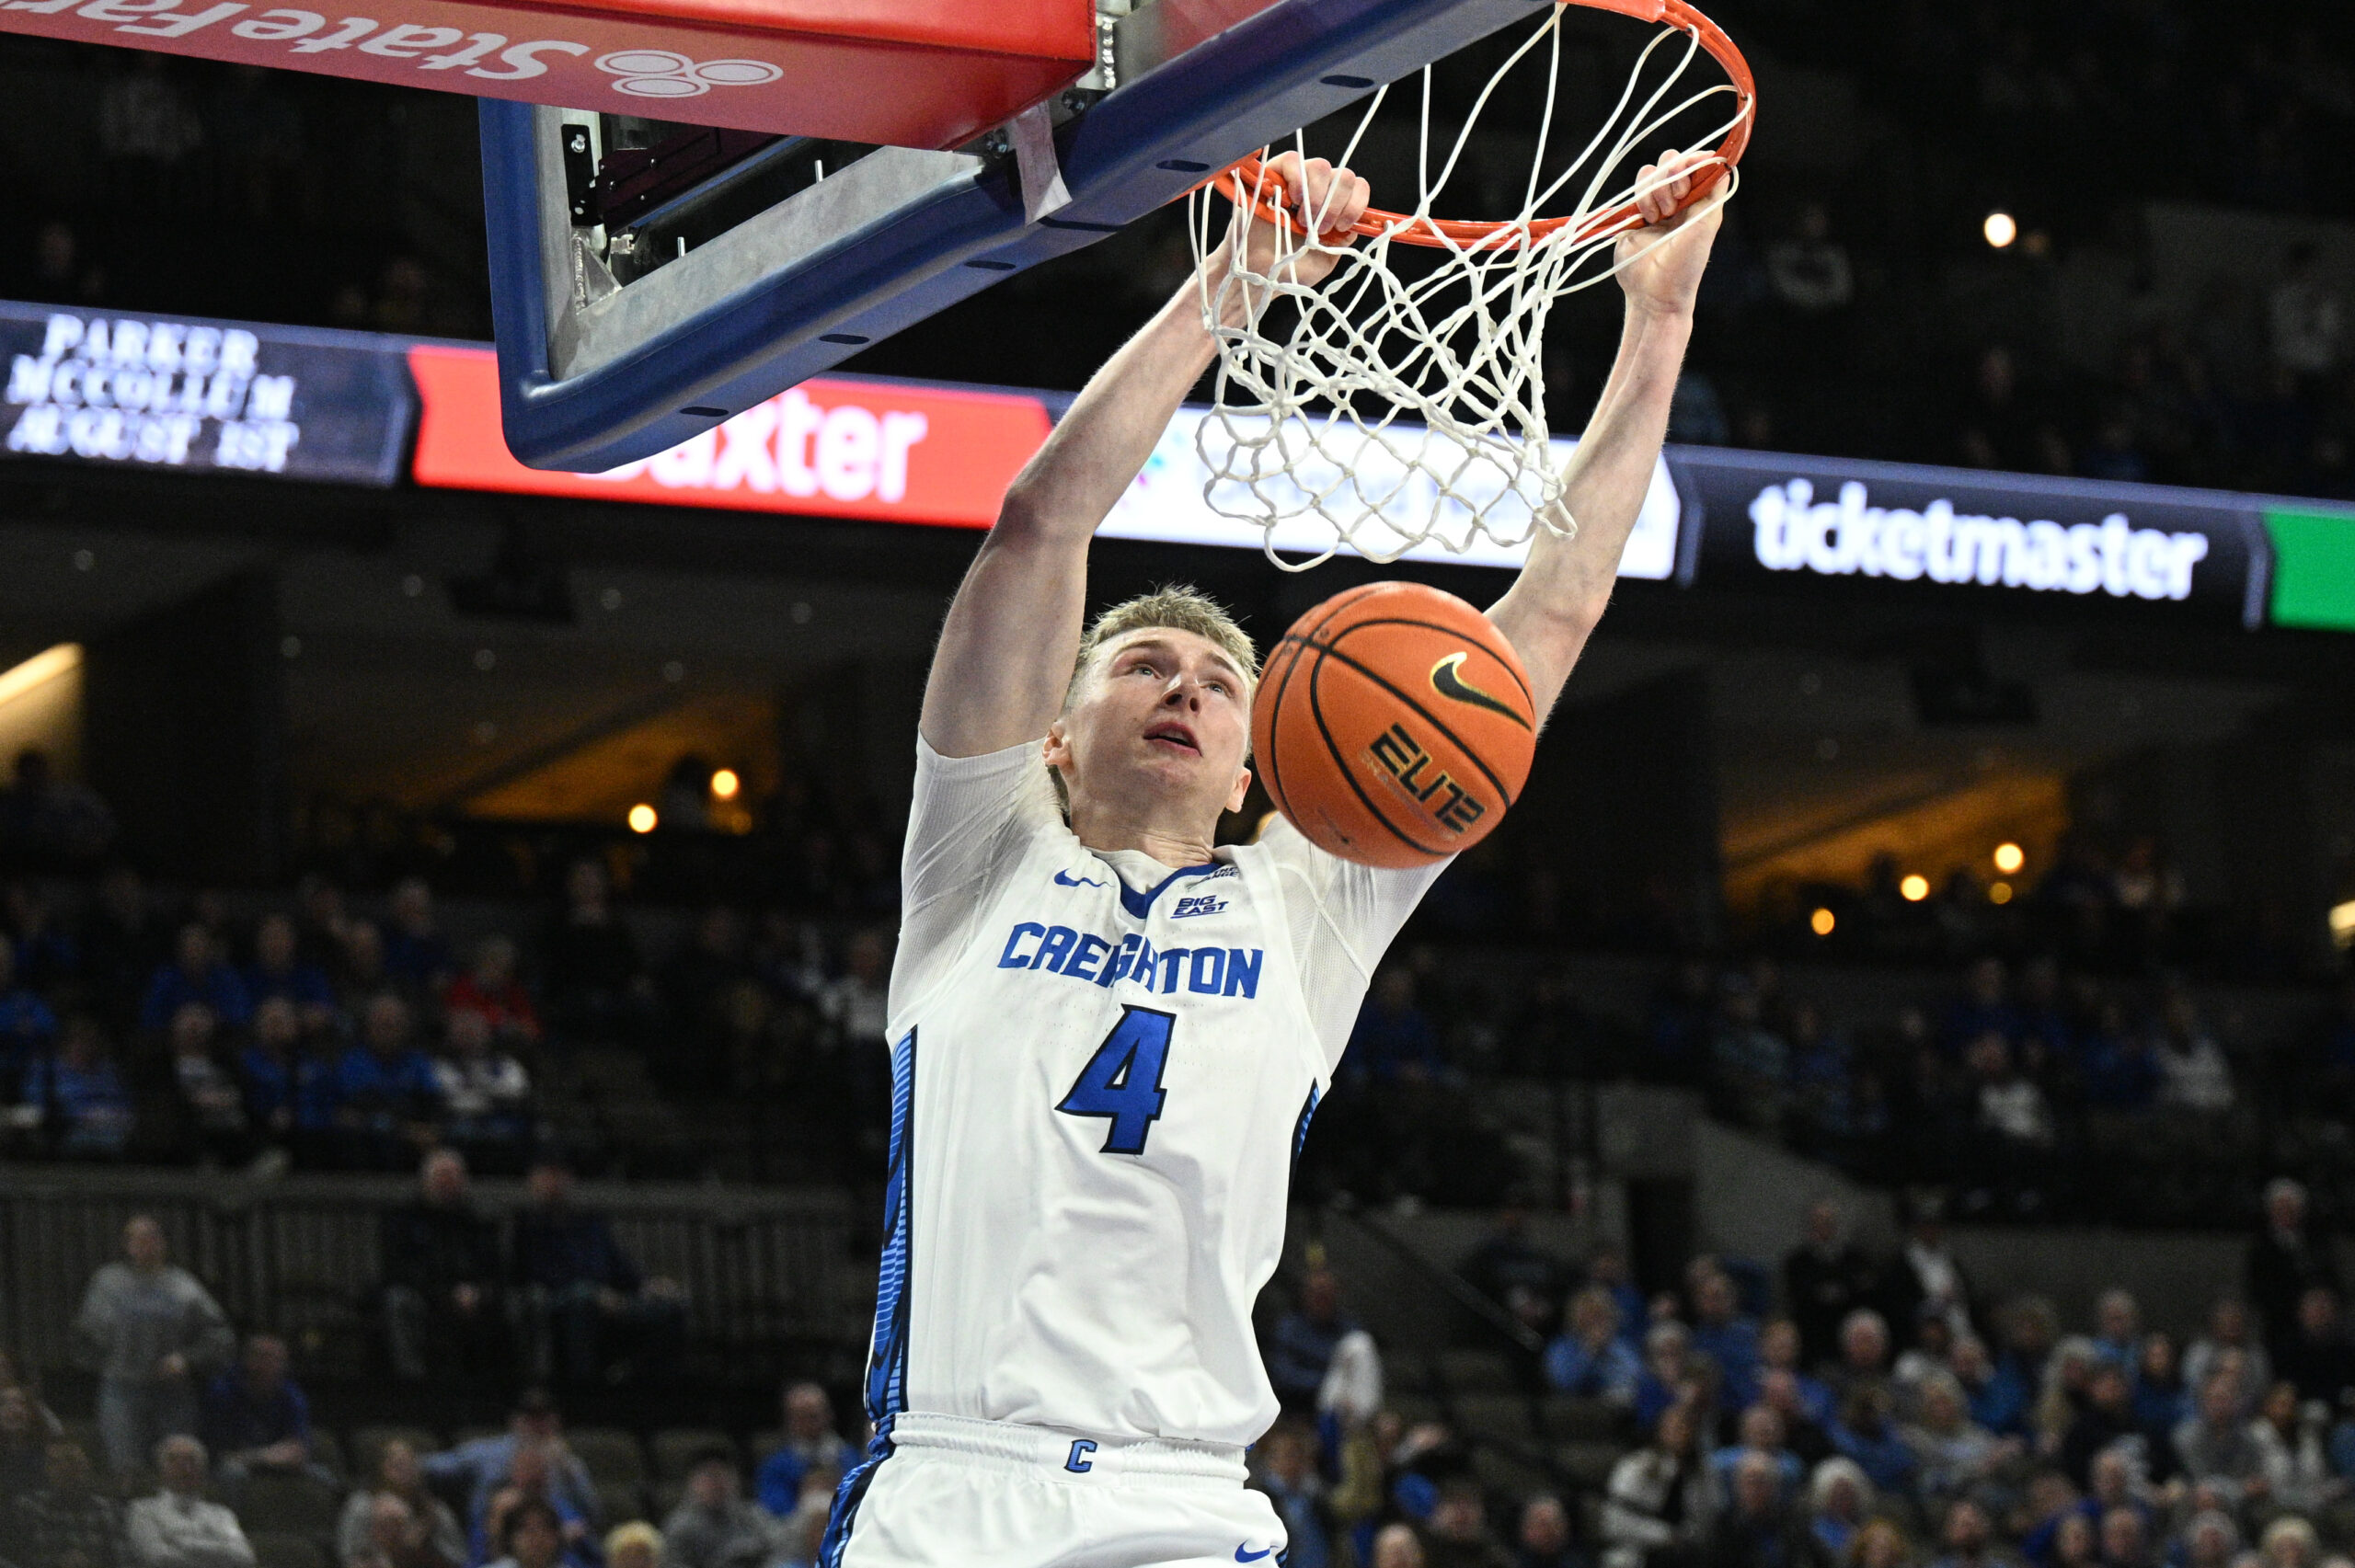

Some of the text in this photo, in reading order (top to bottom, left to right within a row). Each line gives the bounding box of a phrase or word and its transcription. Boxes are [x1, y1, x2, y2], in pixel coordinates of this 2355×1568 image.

[42, 314, 259, 377] PARKER
[7, 403, 201, 464] AUGUST
[575, 387, 929, 503] axter
[1749, 478, 2208, 600] ticketmaster
[1369, 722, 1487, 834] ELITE
[1173, 901, 1229, 916] EAST
[1178, 895, 1217, 908] BIG
[997, 921, 1264, 1000] CREIGHTON
[1054, 1003, 1177, 1155] 4
[1063, 1439, 1097, 1473] C
